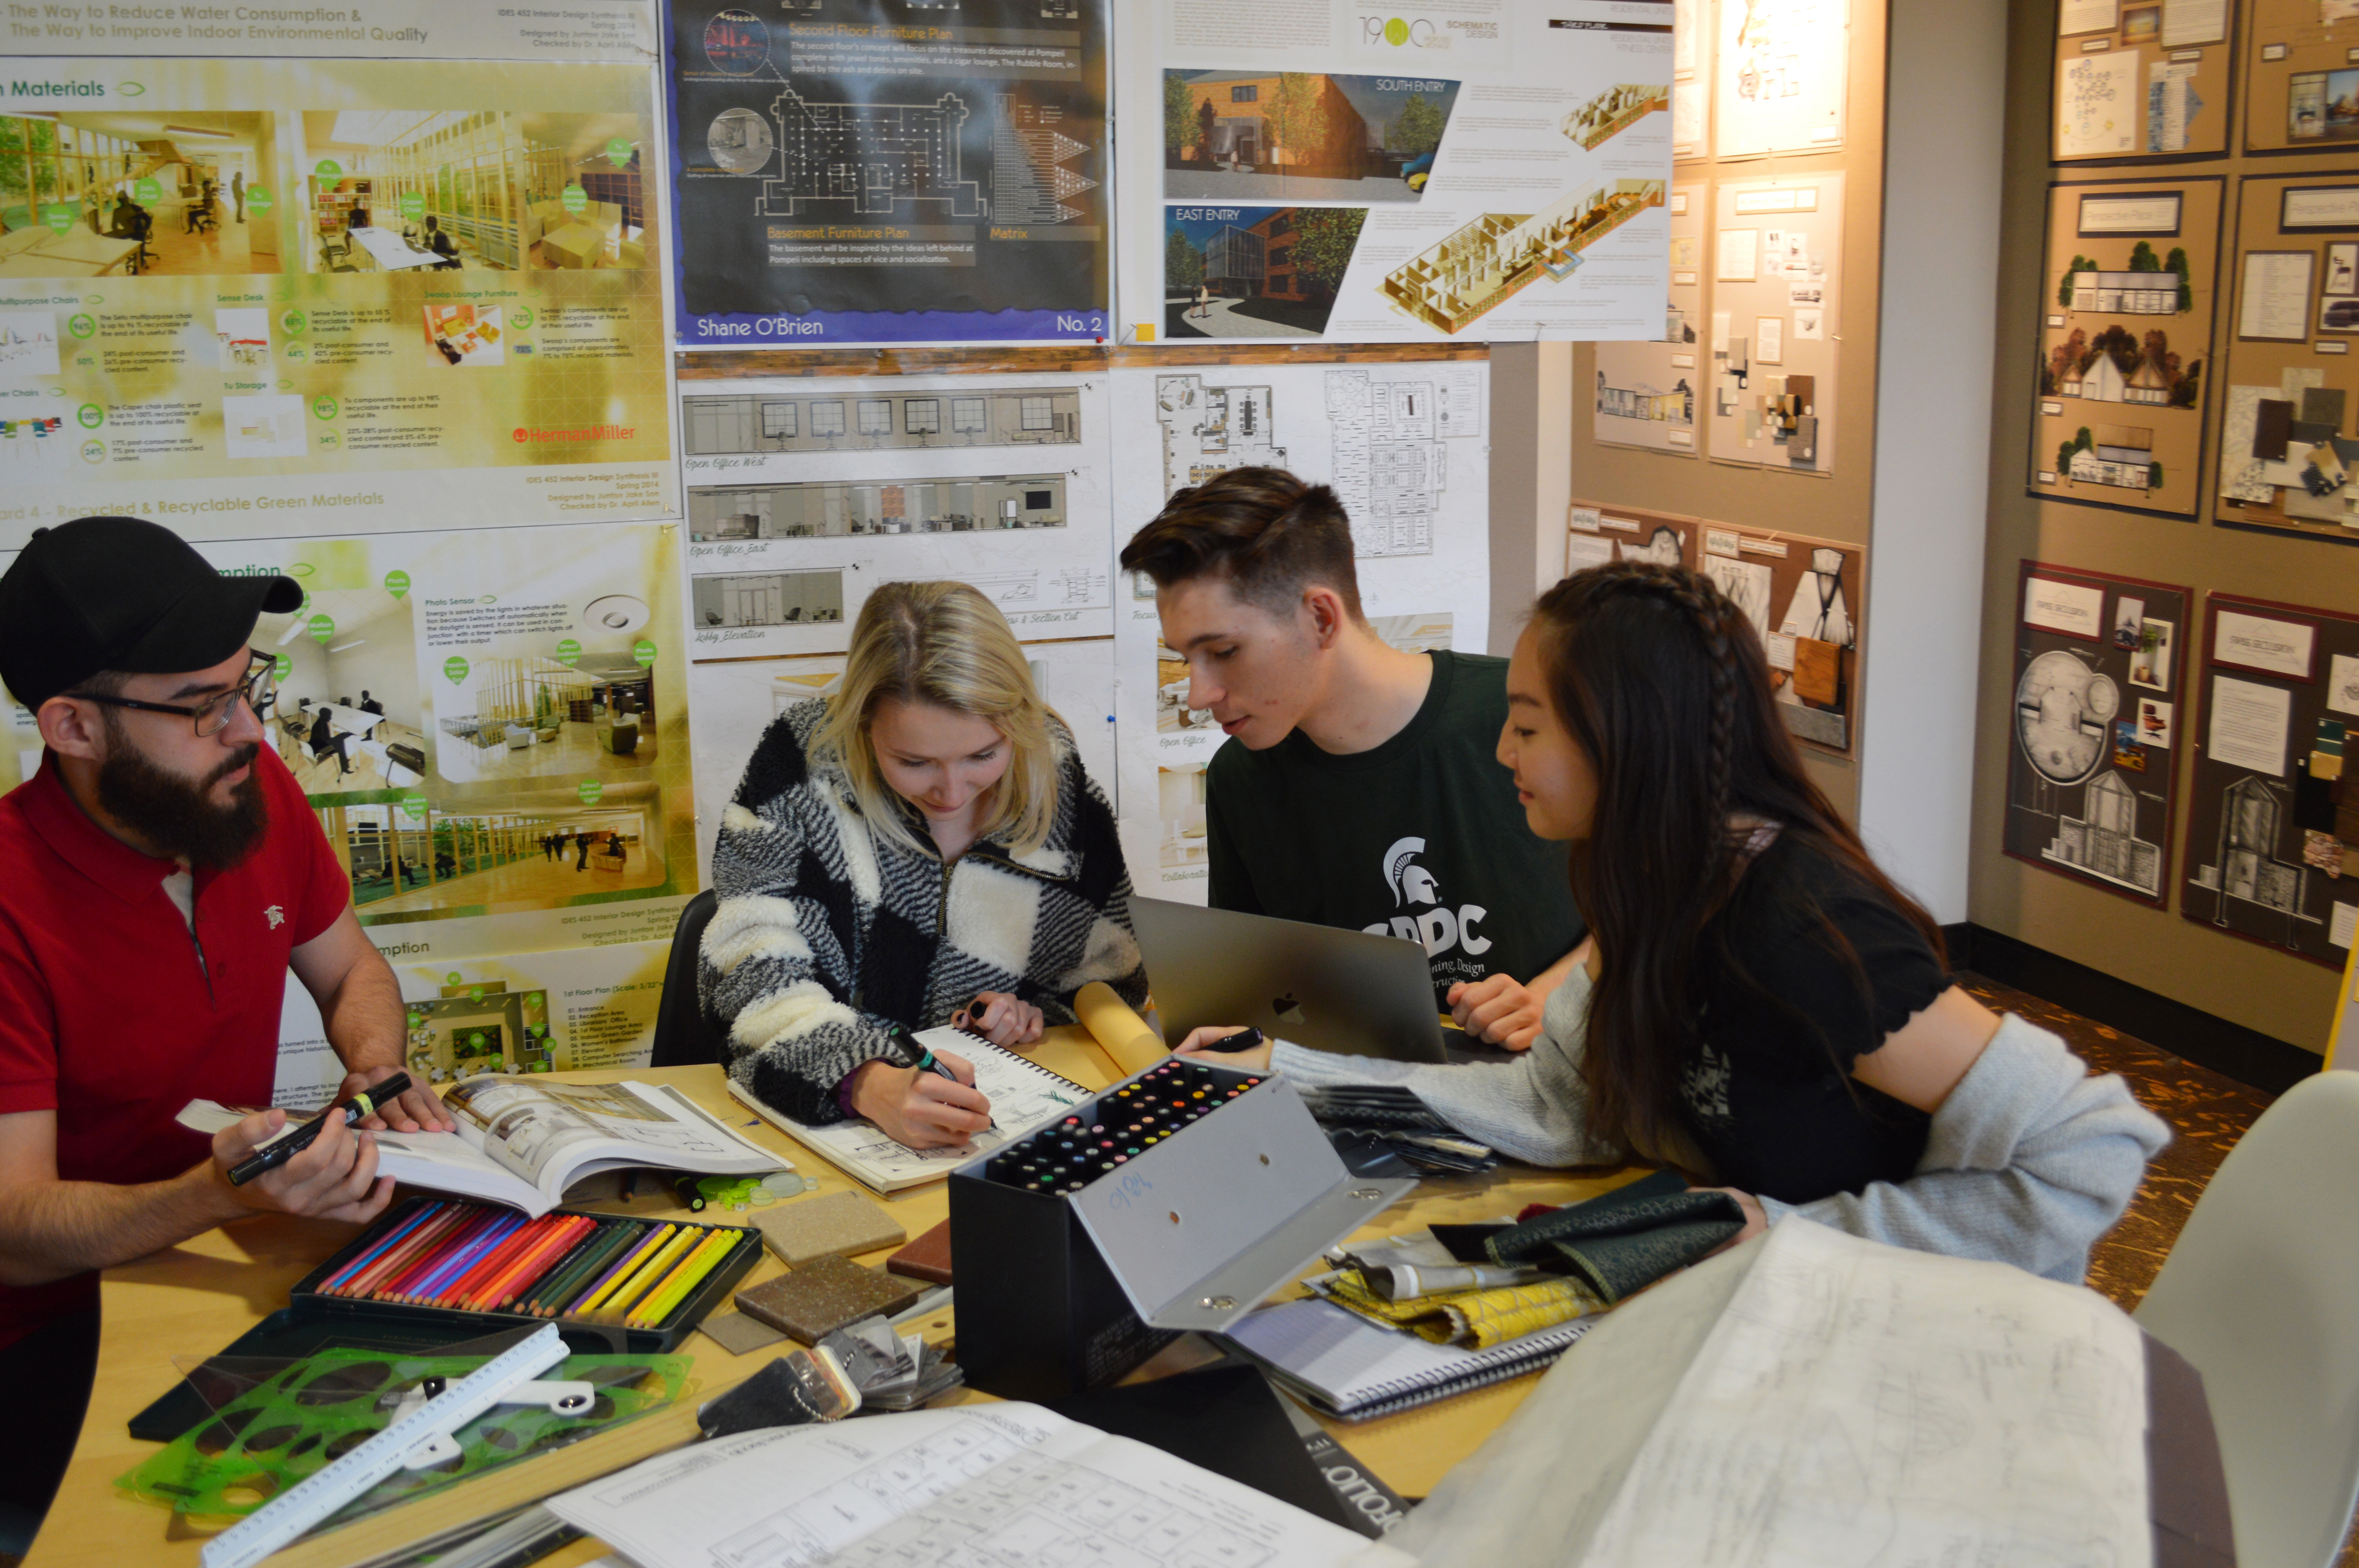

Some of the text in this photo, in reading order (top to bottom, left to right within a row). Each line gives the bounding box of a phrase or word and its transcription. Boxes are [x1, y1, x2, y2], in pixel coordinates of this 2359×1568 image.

[9, 4, 362, 24] The Way to Reduce Water Consumption &
[789, 24, 953, 40] Second Floor Furniture Plan
[1447, 21, 1498, 30] SCHEMATIC
[11, 23, 428, 43] The Way to Improve Indoor Environmental Quality
[1466, 30, 1498, 38] DESIGN
[12, 80, 105, 96] Materials
[1376, 79, 1446, 93] SOUTH ENTRY
[1176, 209, 1240, 220] EAST ENTRY
[767, 226, 909, 239] Basement Furniture Plan
[990, 227, 1028, 239] Matrix
[849, 245, 879, 253] inspired
[880, 245, 890, 253] by
[769, 256, 801, 264] Pompeii
[801, 256, 836, 265] including
[0, 298, 49, 306] ultipurpose
[698, 318, 823, 336] Shane O'Brien
[1057, 315, 1102, 331] No. 2
[529, 425, 636, 443] HermanMiller
[685, 456, 769, 470] Open Office West
[30, 506, 40, 518] 4
[57, 502, 136, 517] Recycled
[142, 502, 153, 514] &
[158, 497, 251, 515] Recyclable
[256, 496, 306, 509] Green
[312, 492, 385, 507] Materials
[690, 543, 771, 557] Open Office East
[218, 564, 280, 577] mption
[1030, 612, 1061, 623] Section
[1064, 610, 1082, 621] Cut
[1132, 610, 1157, 619] Focus
[695, 629, 765, 644] Lobby Elevation
[1159, 735, 1207, 749] Open Office
[1162, 869, 1209, 882] Collaboratio
[377, 942, 430, 957] mption
[1457, 958, 1485, 977] Design
[612, 984, 638, 993] (Scale:
